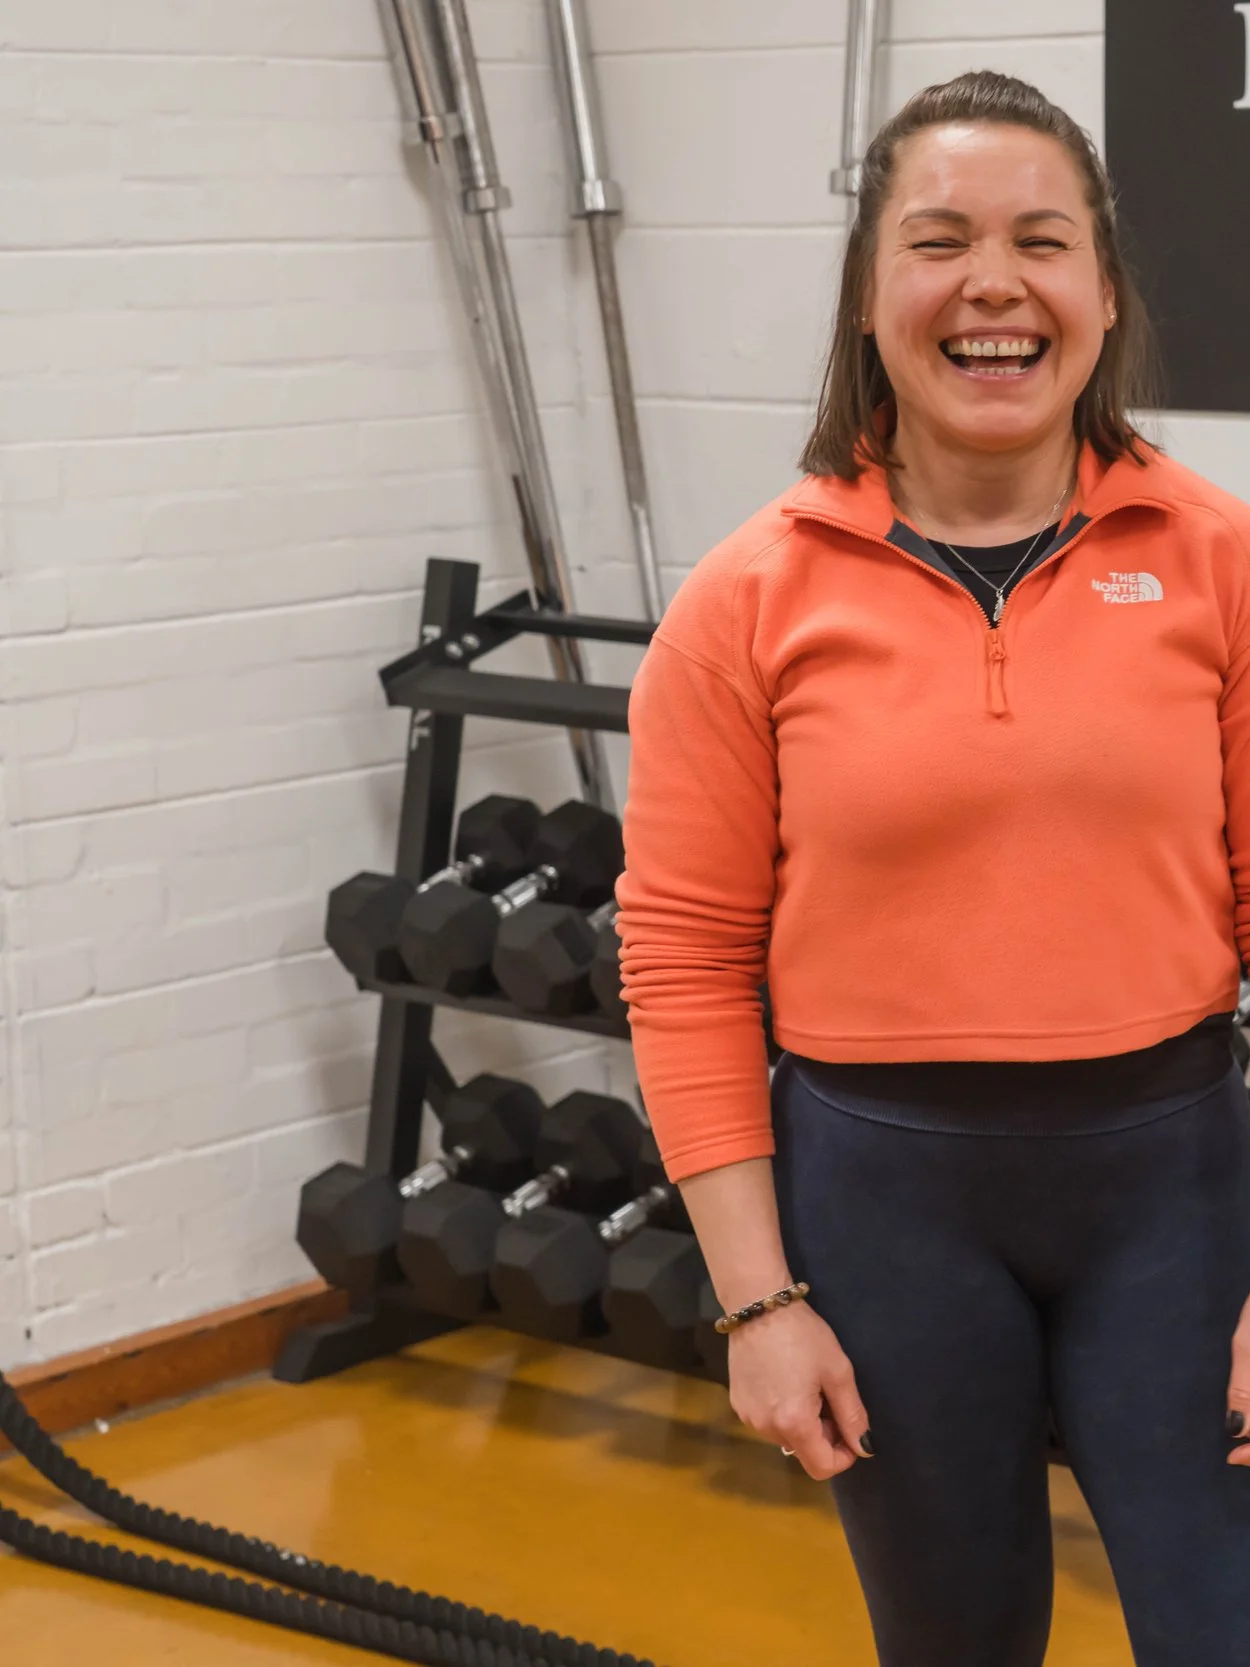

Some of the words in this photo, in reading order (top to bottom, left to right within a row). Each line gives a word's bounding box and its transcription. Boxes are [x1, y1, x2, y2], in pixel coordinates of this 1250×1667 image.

[1108, 572, 1138, 583] THE
[1091, 578, 1138, 594] NORTH
[1103, 592, 1137, 604] FACE
